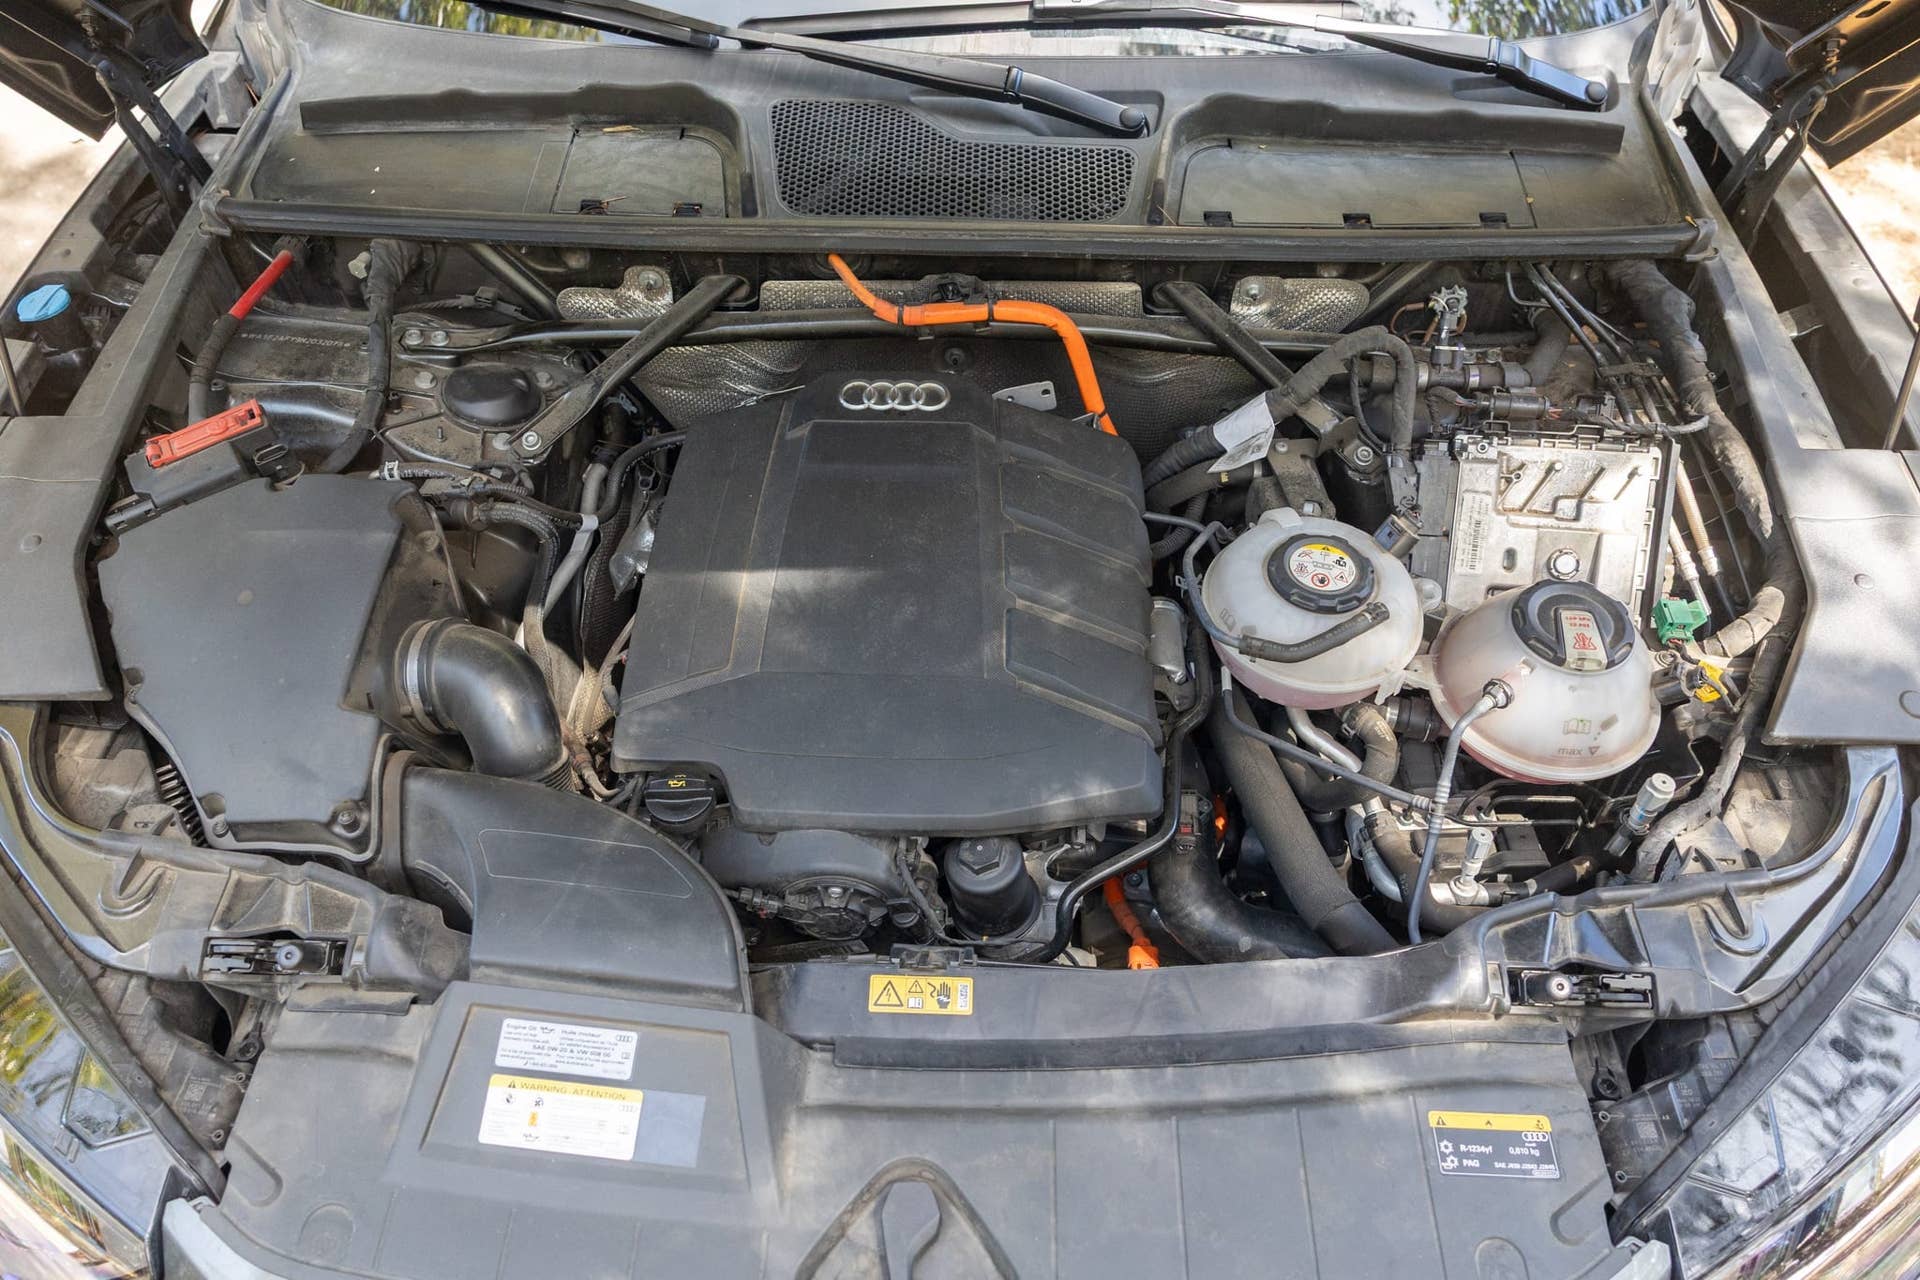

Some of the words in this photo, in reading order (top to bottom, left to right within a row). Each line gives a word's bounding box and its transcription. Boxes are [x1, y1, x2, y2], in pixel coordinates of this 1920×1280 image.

[506, 1023, 527, 1032] Engine
[520, 1082, 567, 1095] WARNING
[572, 1089, 627, 1101] ATTENTION
[1460, 1144, 1493, 1155] R-1234yf
[1530, 1147, 1540, 1157] kg
[1463, 1159, 1480, 1168] PAG
